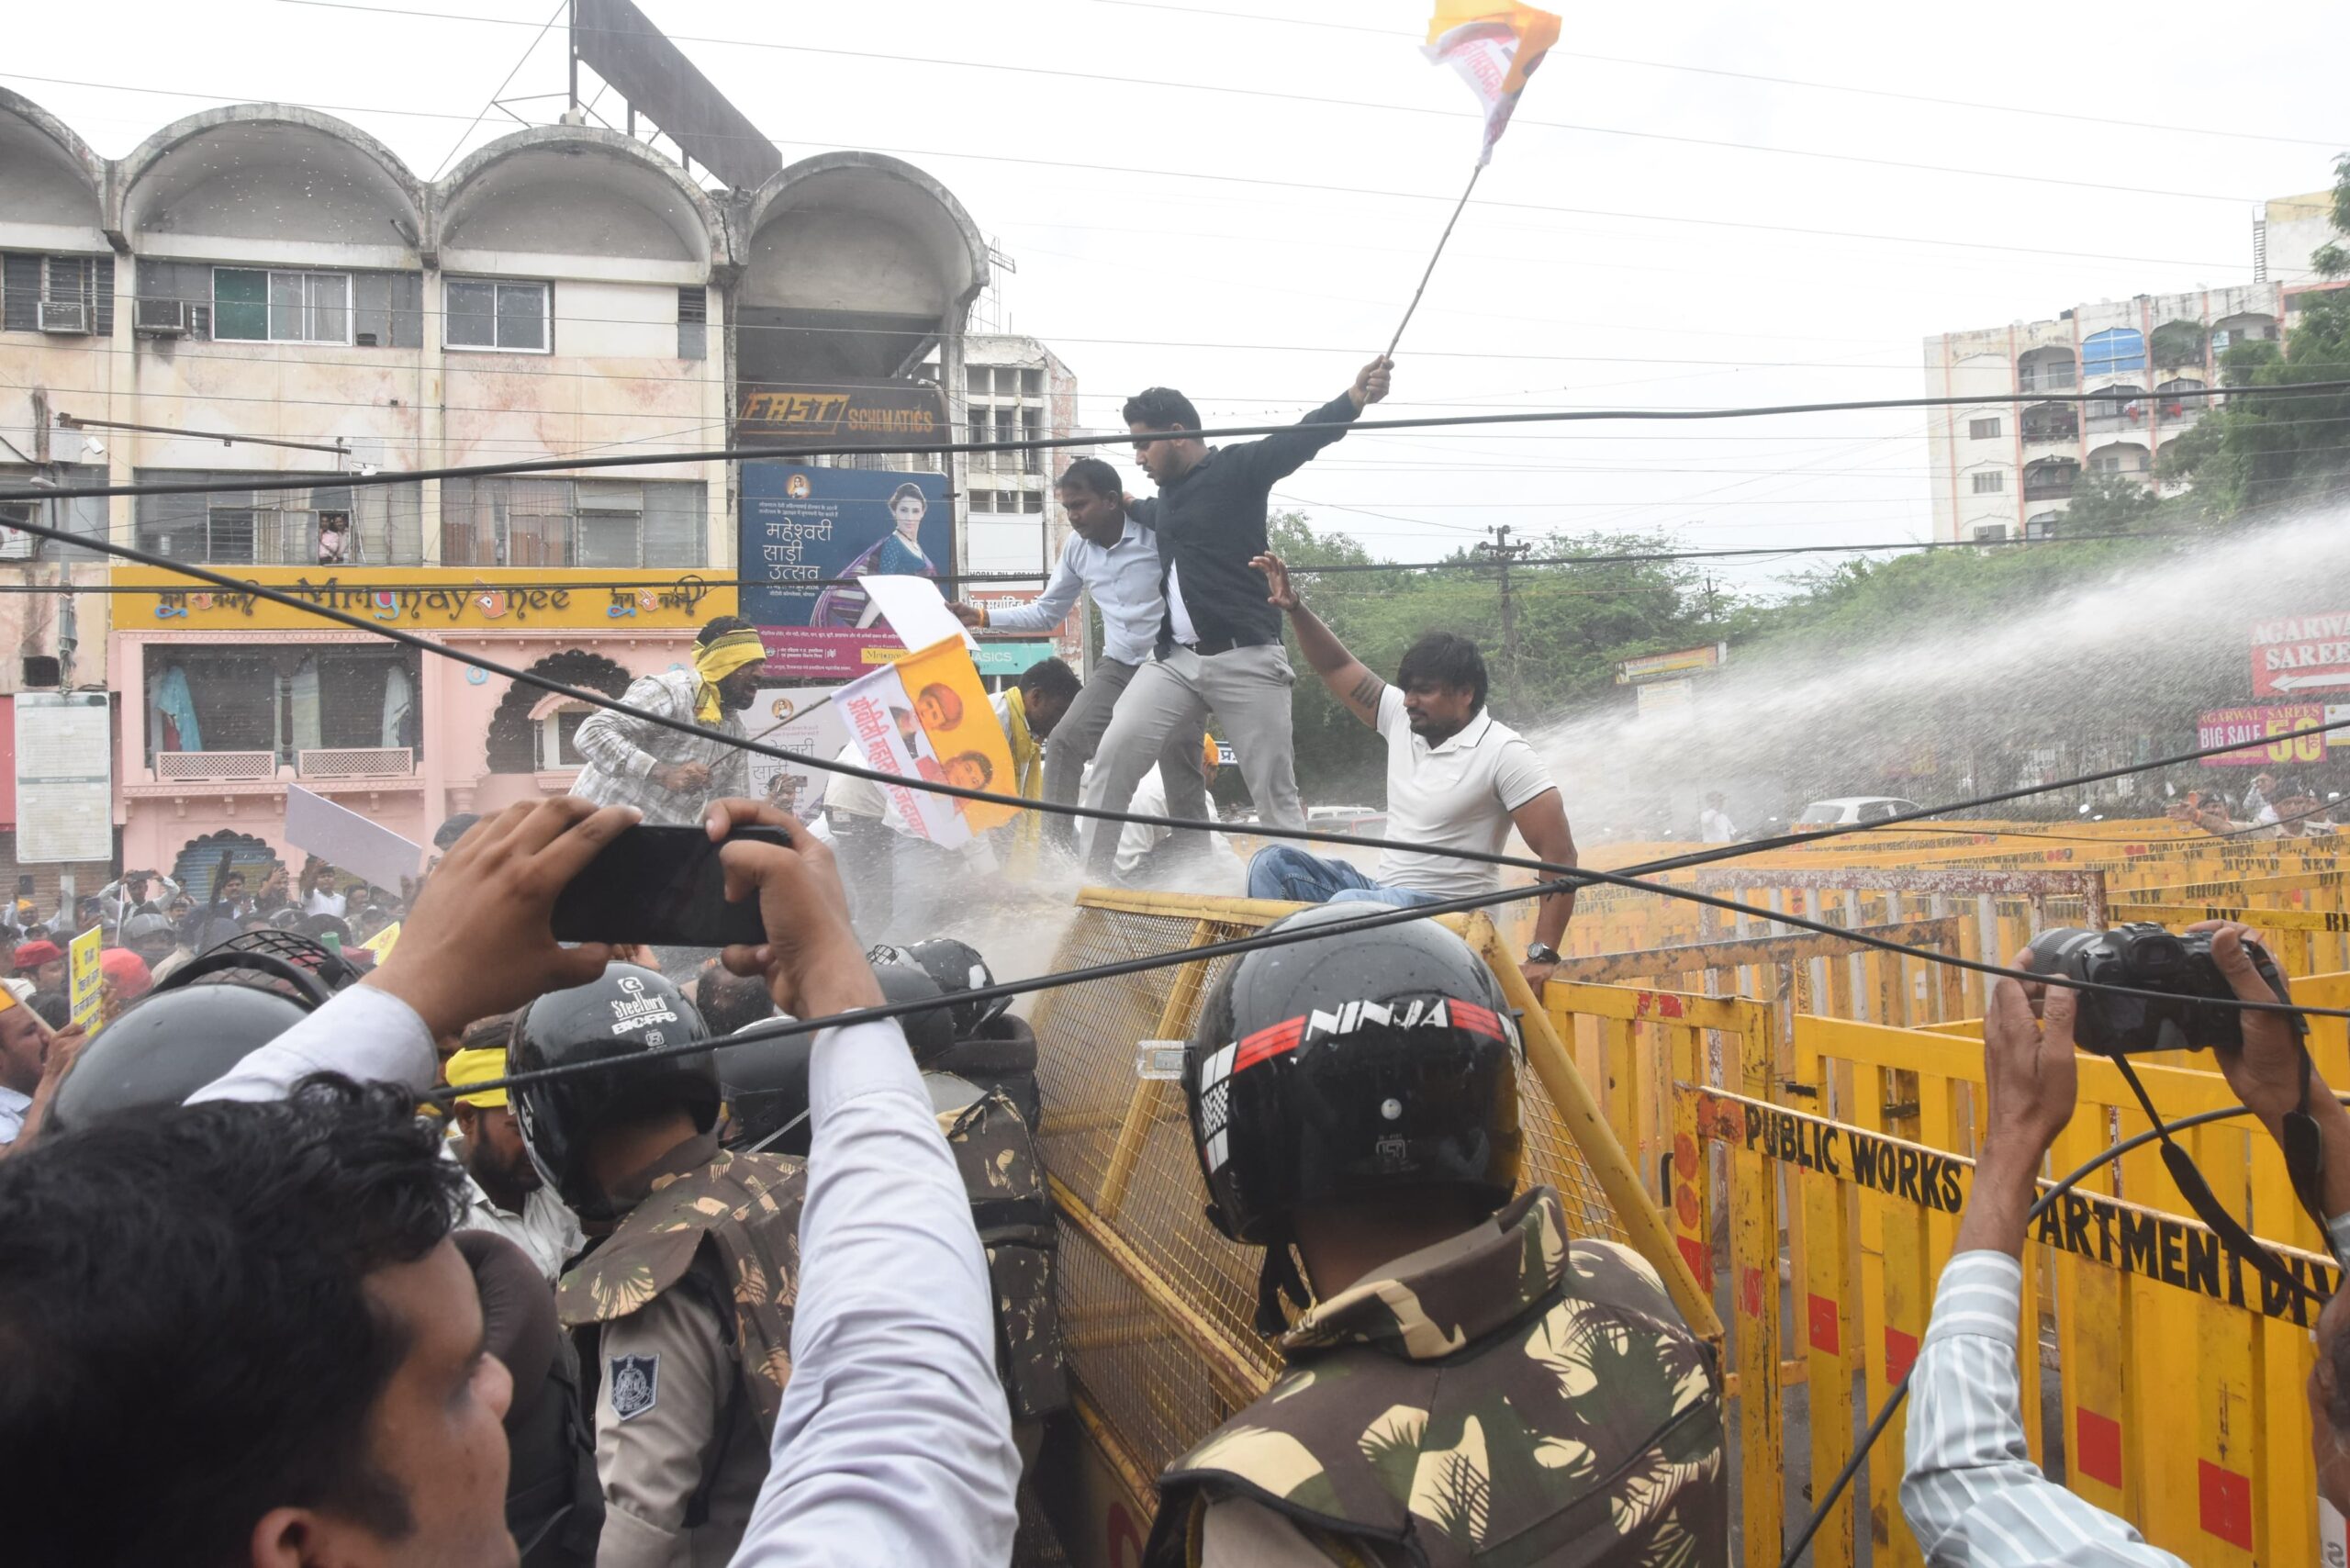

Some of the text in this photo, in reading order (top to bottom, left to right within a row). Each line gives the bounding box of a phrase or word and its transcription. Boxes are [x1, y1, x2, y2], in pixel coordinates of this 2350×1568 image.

[747, 394, 934, 433] FAST SCHEMATICS
[766, 517, 833, 541] महेश्वरी
[762, 539, 804, 565] साड़ी
[768, 564, 822, 581] उत्सव
[2254, 618, 2350, 644] AGARWA
[2266, 644, 2350, 670] SAREE
[847, 695, 890, 743] ओबीसी
[2201, 708, 2263, 724] AGARWAL
[2267, 705, 2320, 720] SAREES
[2200, 724, 2261, 748] BIG SALE
[1305, 999, 1449, 1041] NINJA
[1744, 1102, 1840, 1176] PUBLIC
[1848, 1132, 1963, 1214] WORKS
[2035, 1187, 2246, 1310] ARTMENT
